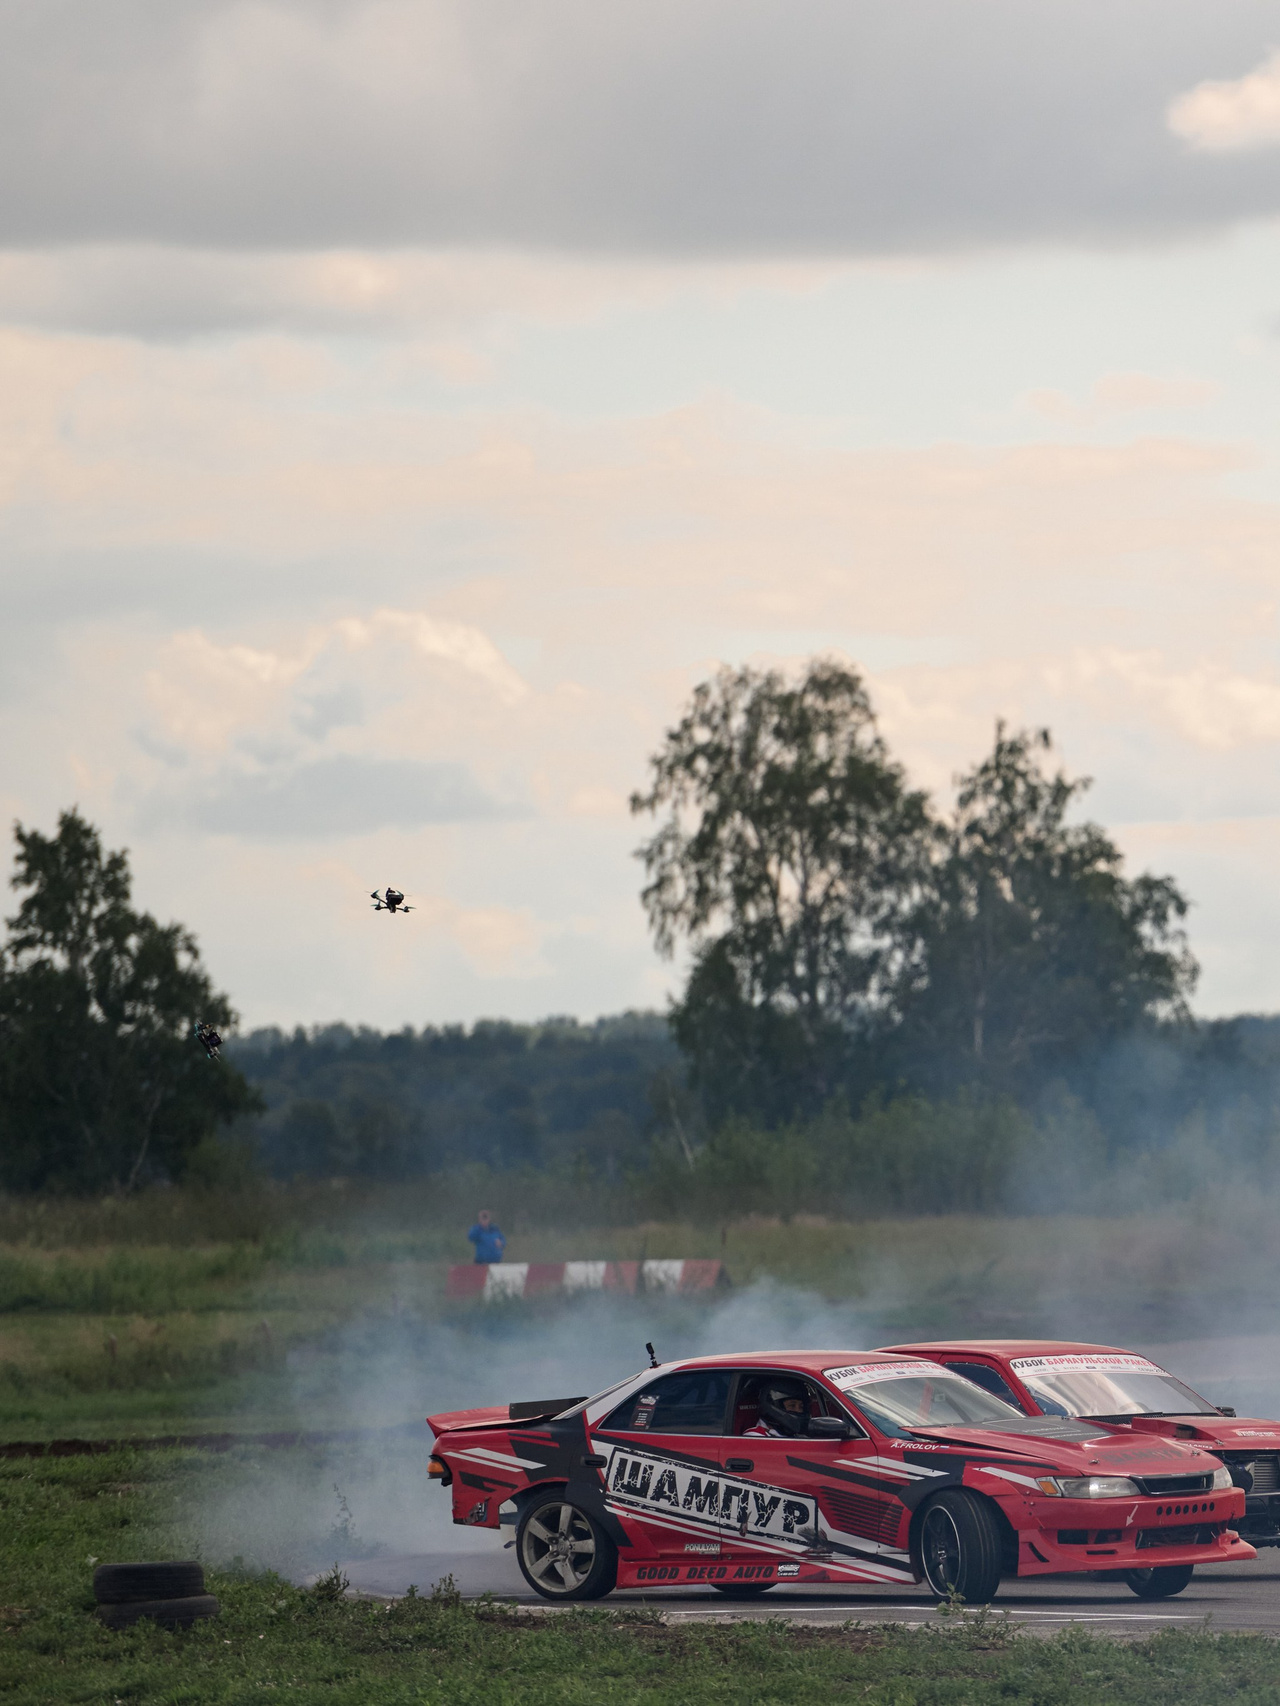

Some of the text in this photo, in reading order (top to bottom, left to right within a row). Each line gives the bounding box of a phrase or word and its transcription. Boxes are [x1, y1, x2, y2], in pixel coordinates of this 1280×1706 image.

[1011, 1359, 1045, 1369] КУБОК
[1045, 1356, 1122, 1366] БАРНАУЛЬСКОЙ
[827, 1367, 859, 1381] КУБОК
[891, 1442, 939, 1450] A.FROLOV
[613, 1457, 810, 1534] ШАМПУР
[637, 1566, 774, 1580] GOOD DEED AUTO
